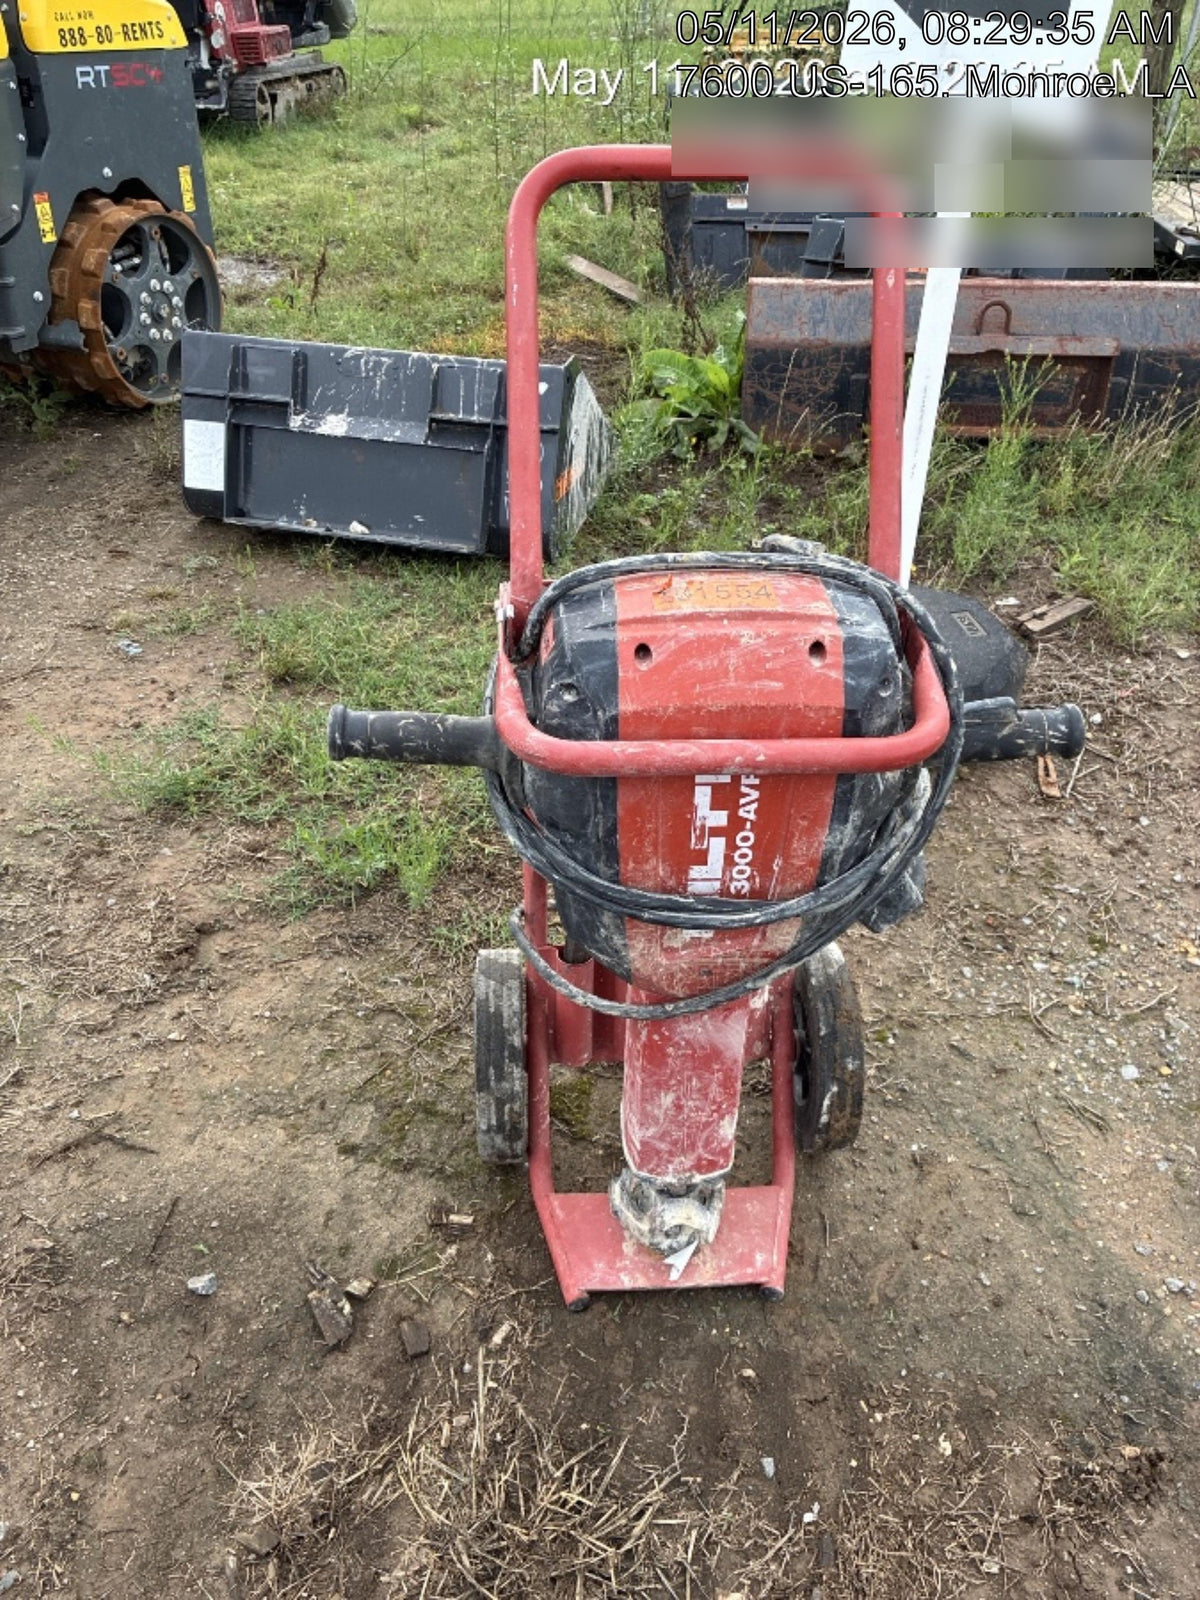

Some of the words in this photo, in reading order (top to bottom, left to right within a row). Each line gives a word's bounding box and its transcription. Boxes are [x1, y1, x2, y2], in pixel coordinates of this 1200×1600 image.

[58, 21, 164, 48] 888-80-RENTS
[661, 582, 773, 602] 1554
[682, 774, 731, 938] ILTI
